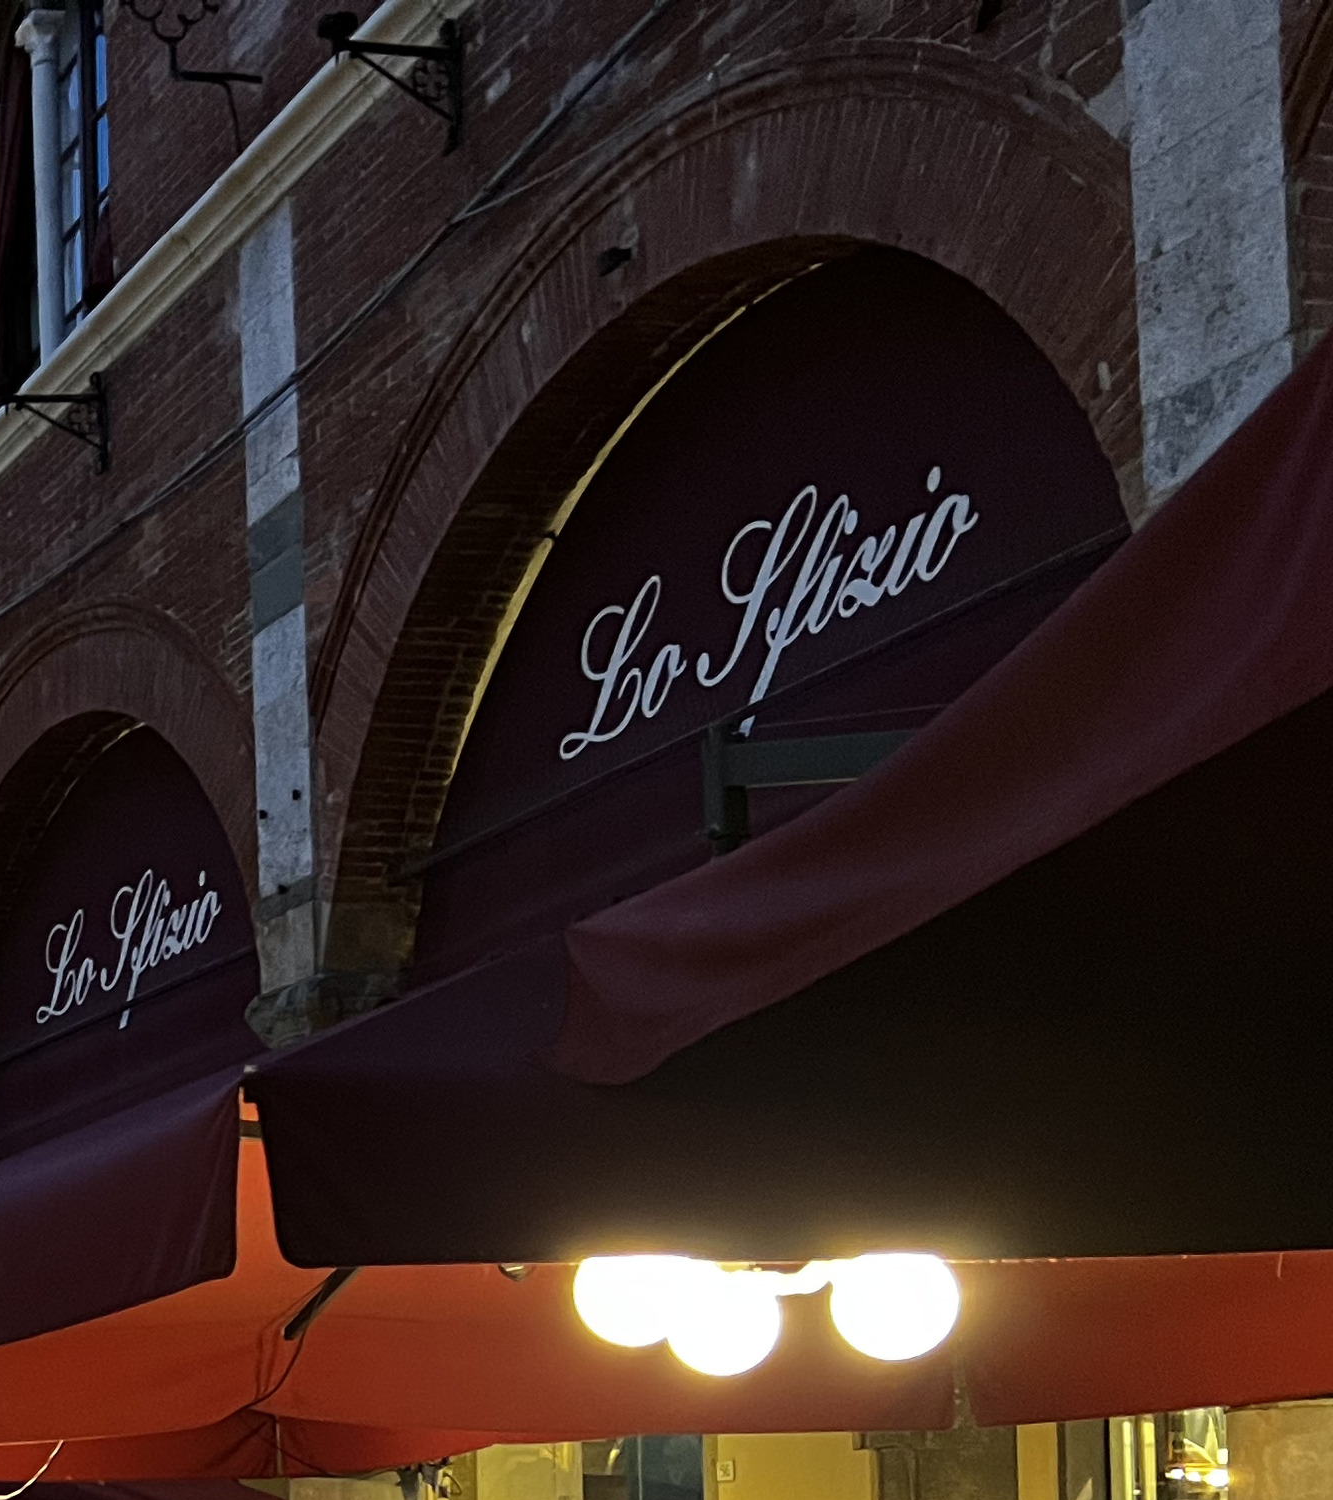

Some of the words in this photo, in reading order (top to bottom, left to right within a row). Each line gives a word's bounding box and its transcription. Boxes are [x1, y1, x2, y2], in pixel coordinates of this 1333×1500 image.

[560, 575, 686, 760] Lo
[696, 466, 979, 738] Sfizio
[36, 909, 97, 1023] Lo
[101, 869, 222, 1030] Sfizio
